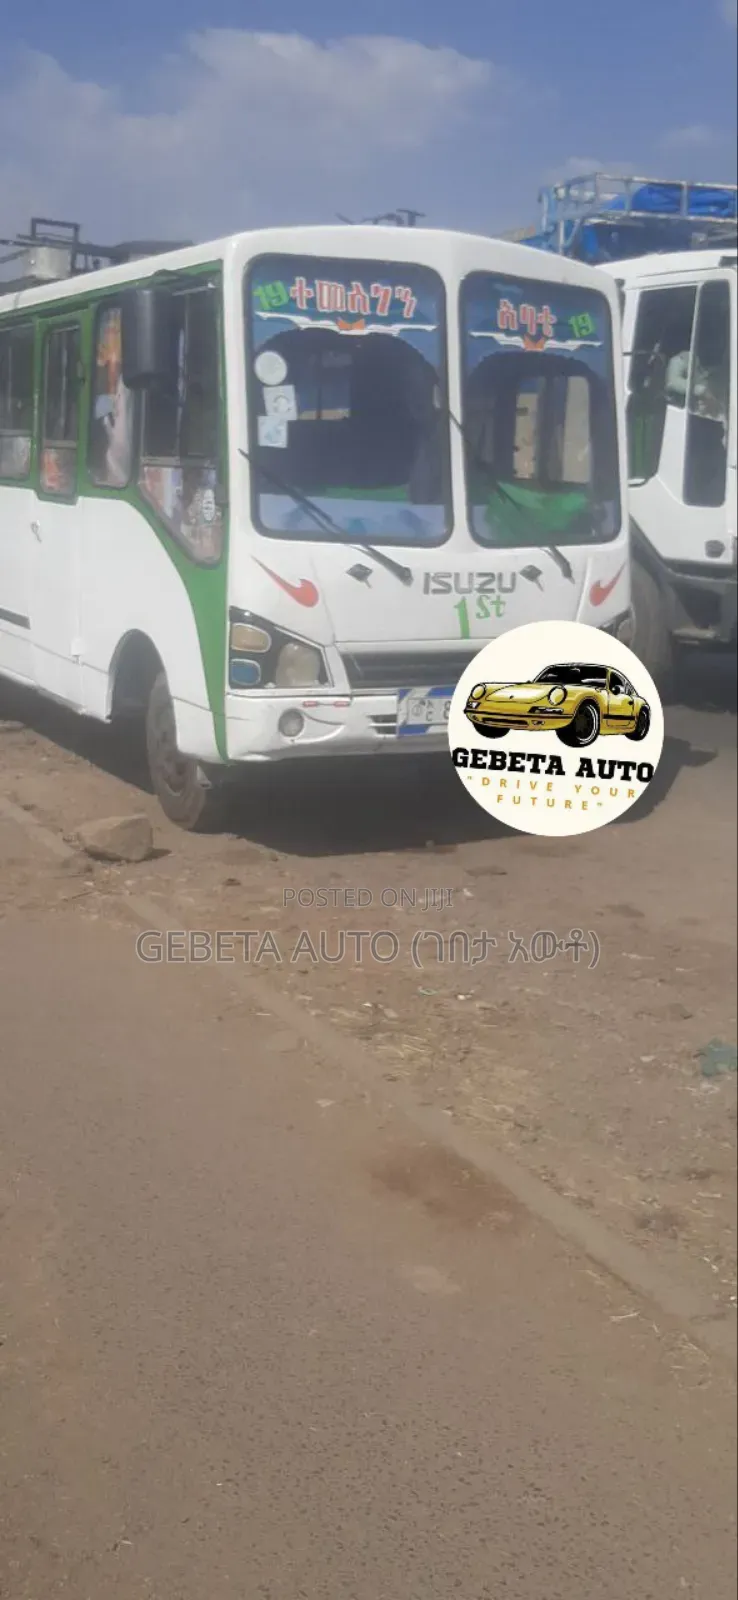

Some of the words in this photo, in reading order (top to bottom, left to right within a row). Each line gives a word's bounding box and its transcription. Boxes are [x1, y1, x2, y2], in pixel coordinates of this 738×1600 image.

[252, 279, 290, 311] 19
[568, 312, 596, 338] 19
[423, 571, 517, 595] ISUZU
